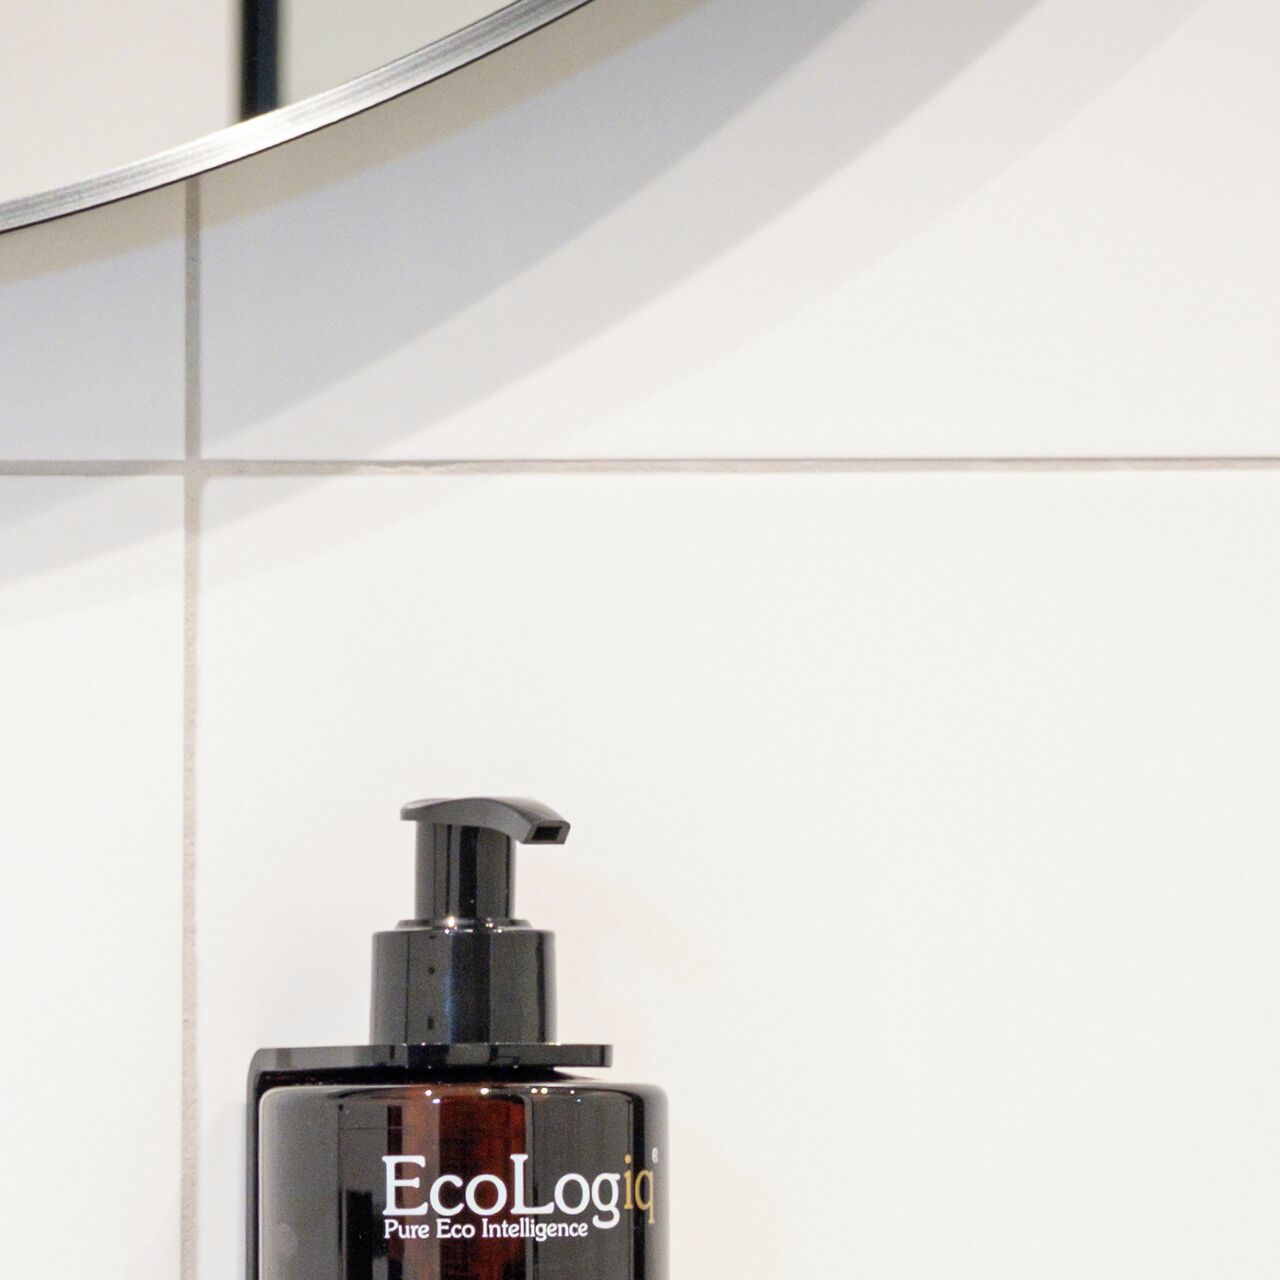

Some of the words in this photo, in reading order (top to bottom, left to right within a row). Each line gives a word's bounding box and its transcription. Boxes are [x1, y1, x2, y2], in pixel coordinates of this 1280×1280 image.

[384, 1219, 430, 1239] Pure
[436, 1219, 475, 1239] Eco
[481, 1217, 588, 1241] Intelligence
